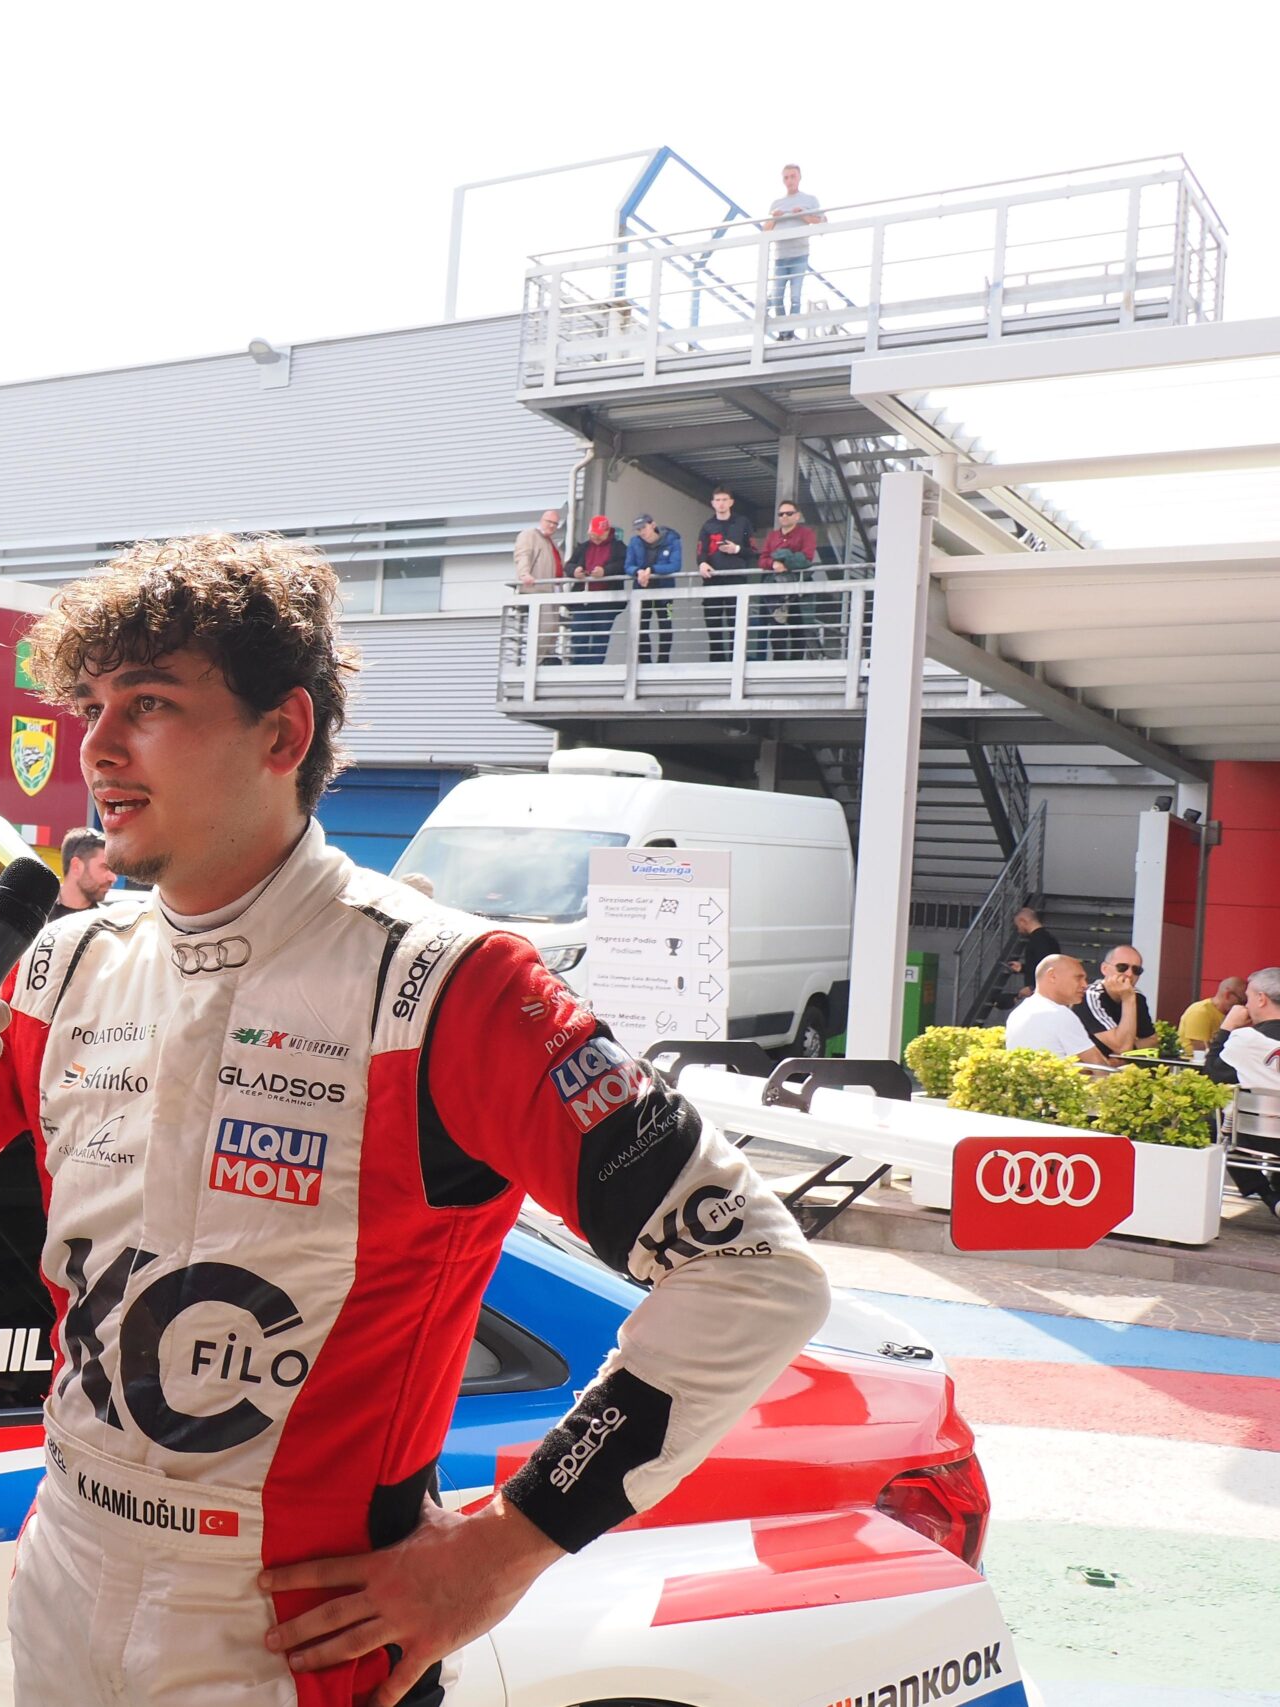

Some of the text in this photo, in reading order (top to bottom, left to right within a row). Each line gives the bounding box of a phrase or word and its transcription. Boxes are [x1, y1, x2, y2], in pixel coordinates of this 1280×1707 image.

[631, 865, 691, 875] Vallelunga
[598, 896, 633, 904] Direzione
[26, 923, 60, 990] parco
[595, 934, 632, 945] Ingresso
[392, 930, 457, 1022] sparco
[288, 1037, 351, 1057] MOTORSPORT
[556, 1037, 628, 1098] LIQU
[81, 1067, 148, 1093] shinko
[218, 1066, 346, 1103] GLADSOS
[98, 1150, 135, 1164] YACHT
[221, 1121, 321, 1167] LIQUI
[598, 1131, 658, 1183] GÜLMARIA
[214, 1156, 320, 1203] MOLY
[58, 1237, 304, 1454] KC
[549, 1406, 628, 1494] sparco
[78, 1471, 195, 1533] K.KAMİLOĞLU
